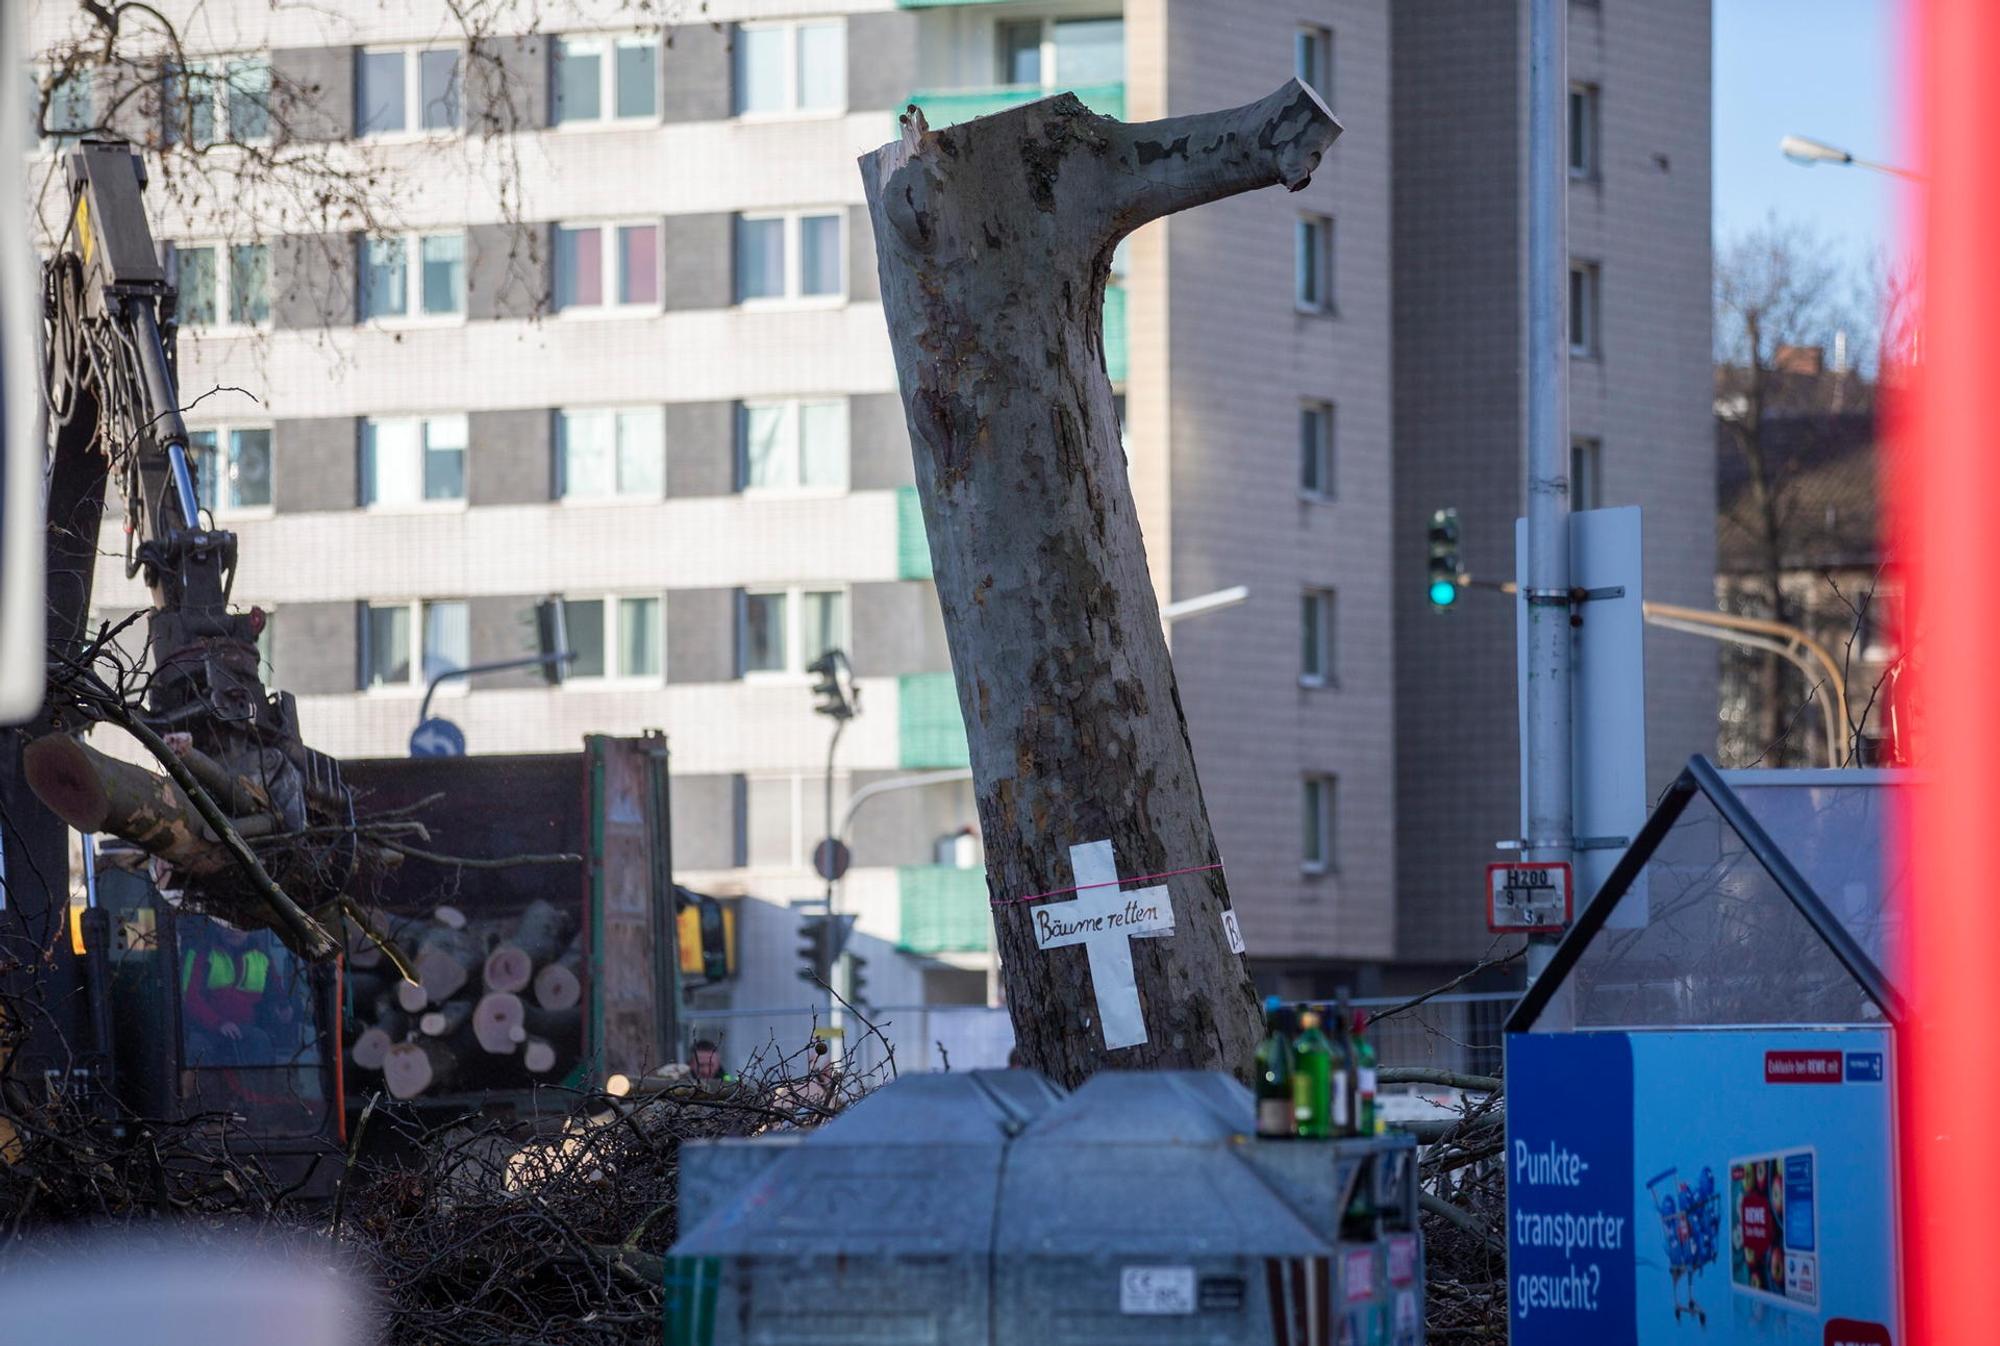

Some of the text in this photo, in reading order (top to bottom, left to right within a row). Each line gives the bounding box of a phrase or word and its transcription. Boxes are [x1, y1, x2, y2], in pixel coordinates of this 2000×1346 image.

[1036, 900, 1158, 944] Bäume retten
[1807, 1059, 1826, 1074] REWE
[1515, 1139, 1589, 1186] Punkte-
[1516, 1208, 1624, 1259] transporter
[1517, 1263, 1600, 1318] gesucht?
